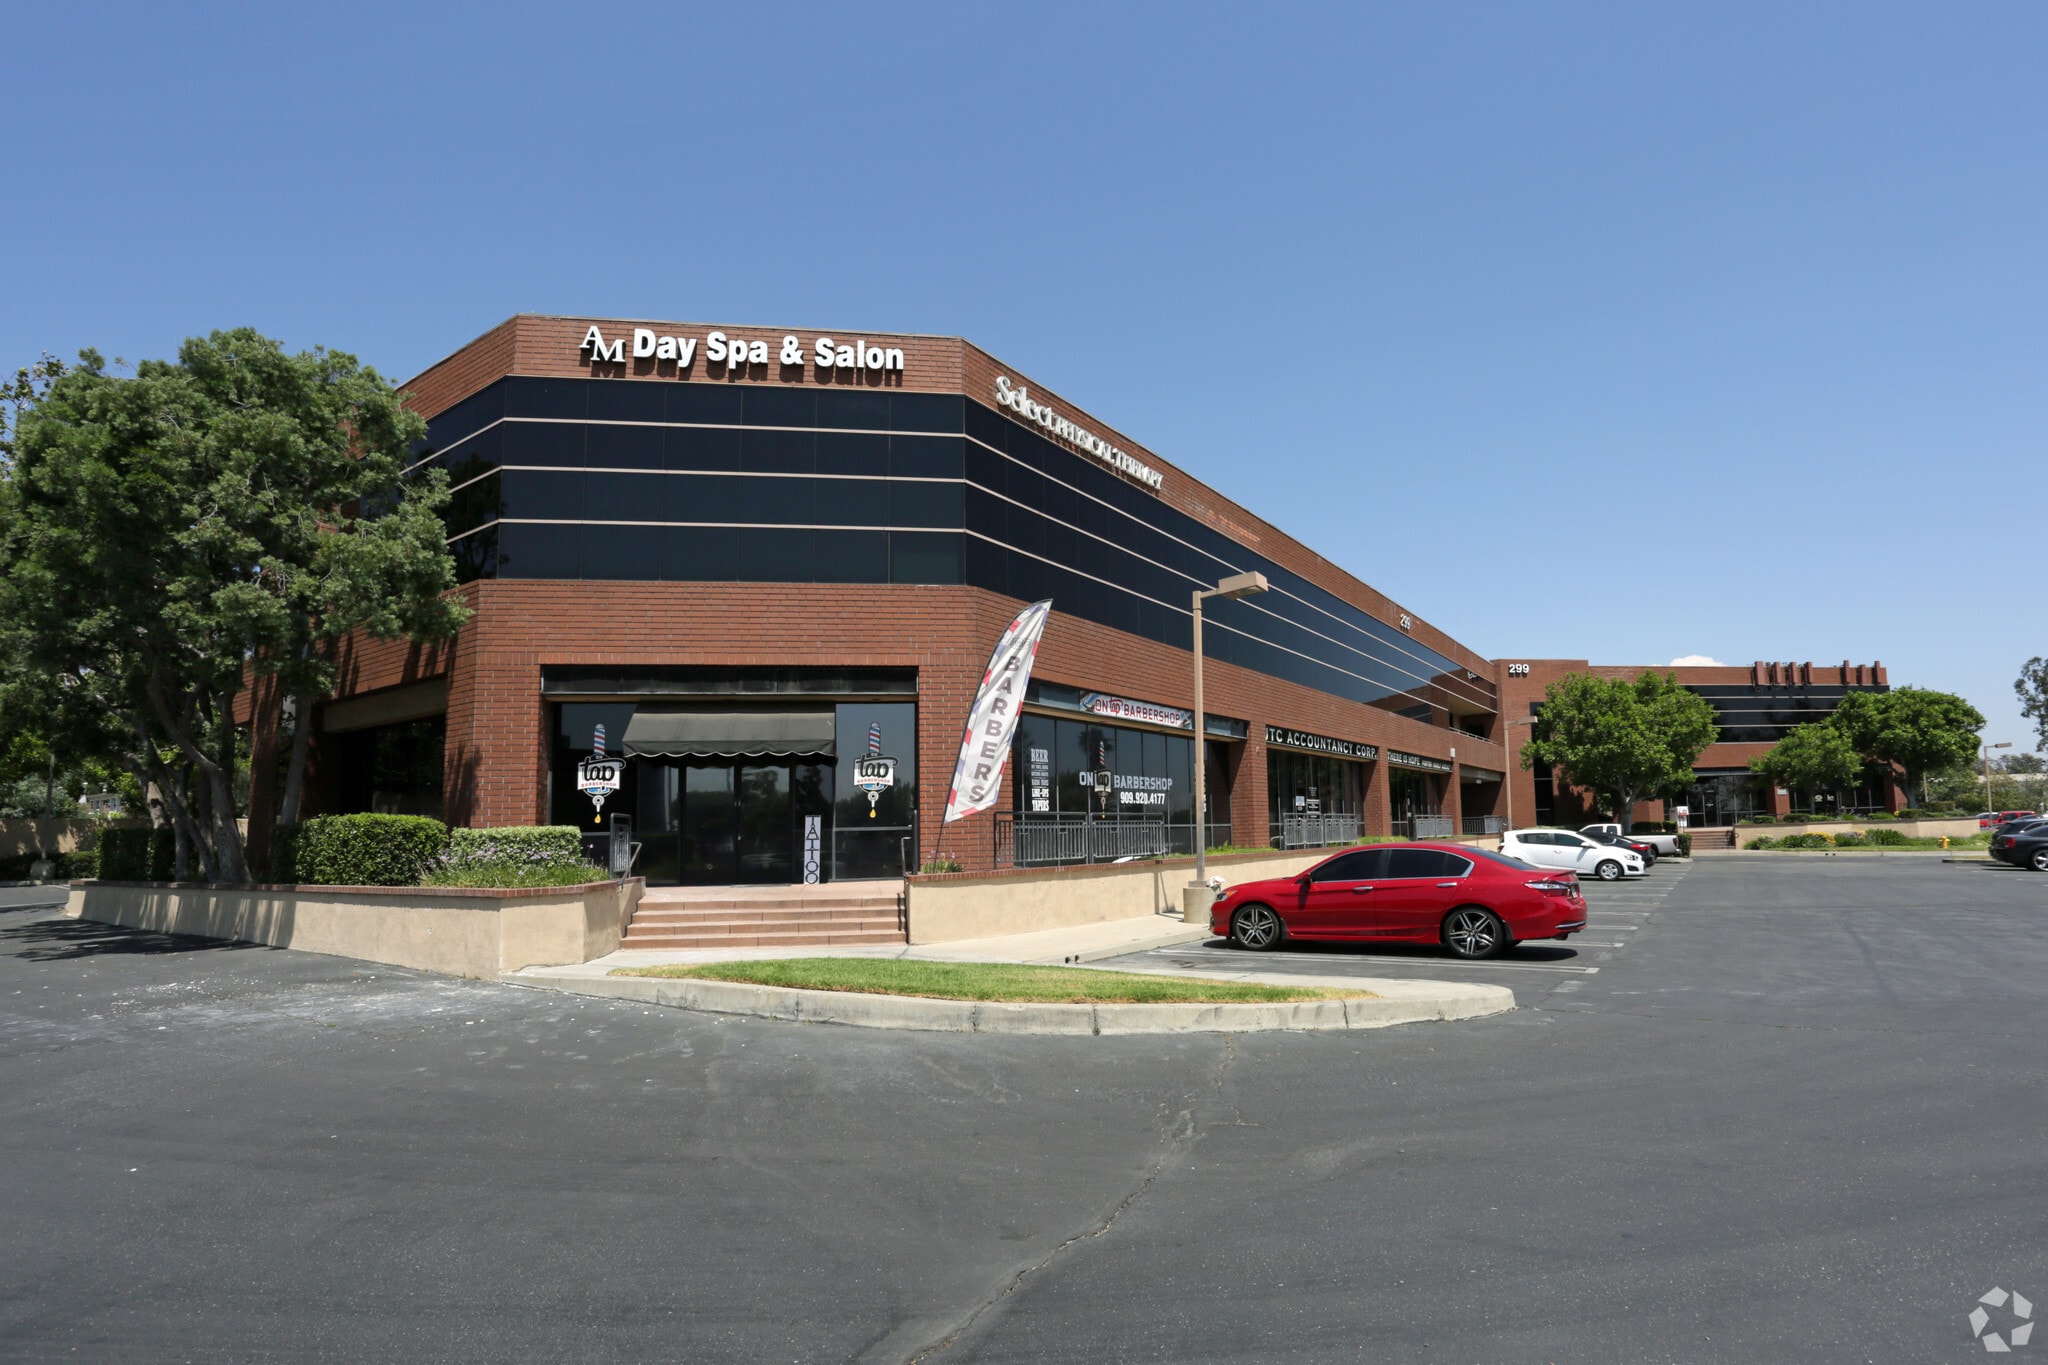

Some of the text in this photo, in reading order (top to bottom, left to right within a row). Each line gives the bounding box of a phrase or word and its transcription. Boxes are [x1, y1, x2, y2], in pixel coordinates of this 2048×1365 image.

[633, 328, 697, 367] Day
[706, 331, 768, 369] Spa
[779, 335, 804, 366] &
[814, 337, 904, 370] Salon
[996, 376, 1056, 431] Select
[1508, 663, 1530, 674] 299
[1095, 698, 1108, 712] ON
[1124, 703, 1180, 725] BARBERSHOP
[969, 656, 1020, 803] BARBERS
[1031, 748, 1049, 762] BEER
[1287, 732, 1353, 754] ACCOUNTANCY
[1356, 744, 1378, 758] CORP.
[1079, 771, 1094, 786] ON
[1113, 774, 1173, 791] BARBERSHOP
[1120, 792, 1166, 805] 909.920.4177
[805, 815, 820, 884] TATTOO
